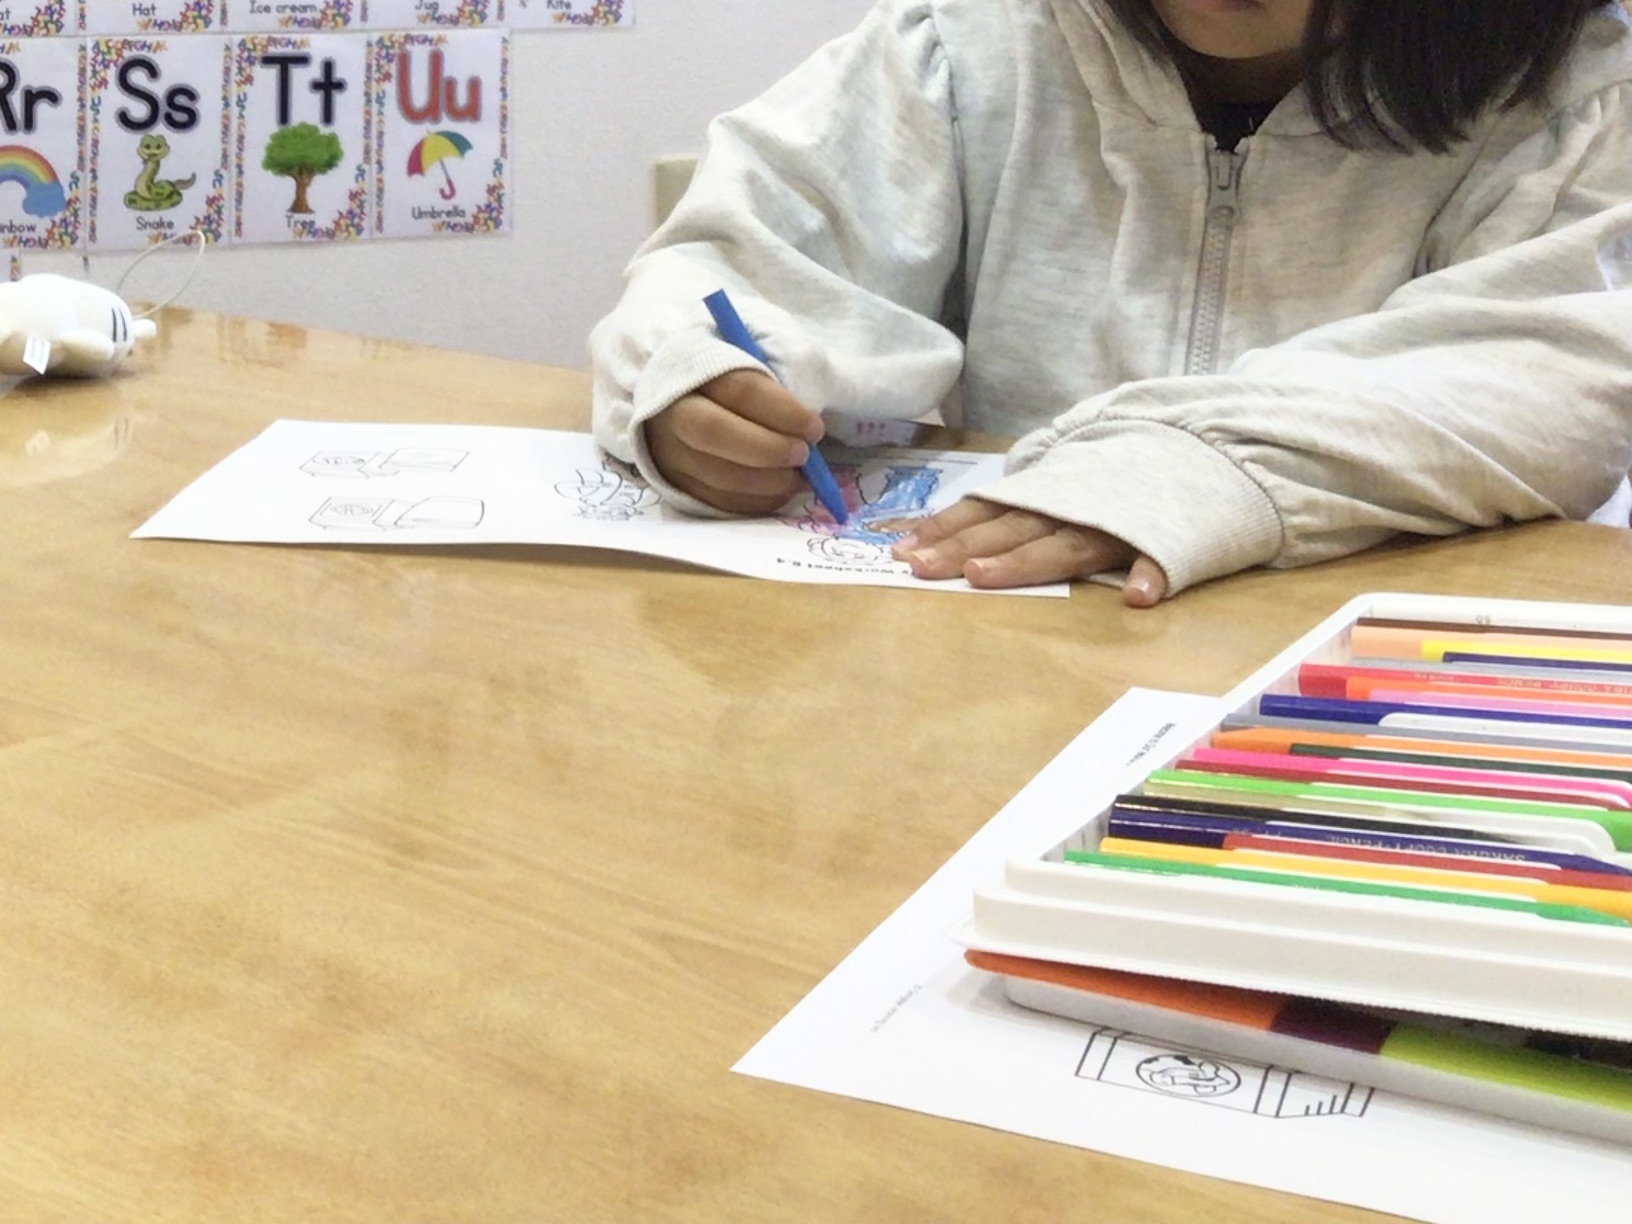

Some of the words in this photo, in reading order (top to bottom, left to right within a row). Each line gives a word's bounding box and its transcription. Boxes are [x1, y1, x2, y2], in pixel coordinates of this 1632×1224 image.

[132, 2, 157, 17] Hat
[248, 0, 272, 15] Ice
[114, 53, 202, 134] Ss
[258, 51, 348, 128] Tt
[394, 47, 483, 126] Uu
[284, 214, 316, 229] Tree
[411, 205, 466, 222] Umbrella
[135, 215, 174, 231] Snake
